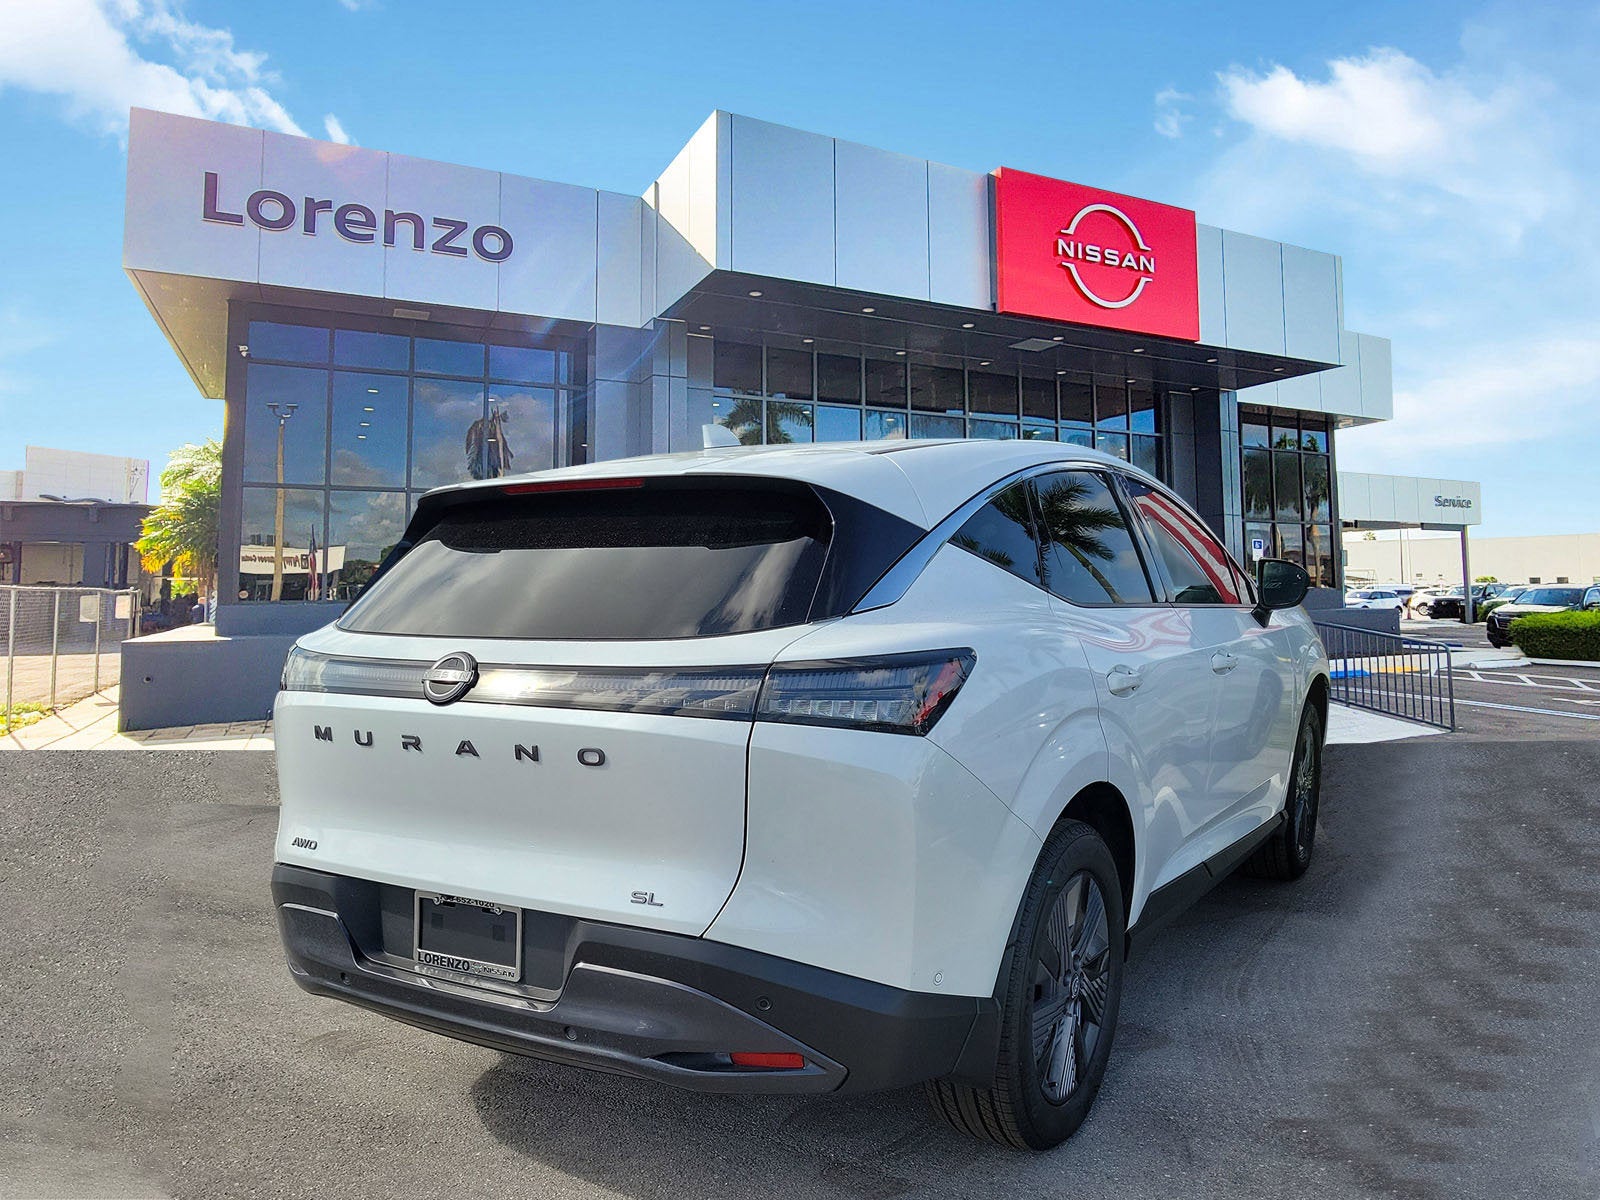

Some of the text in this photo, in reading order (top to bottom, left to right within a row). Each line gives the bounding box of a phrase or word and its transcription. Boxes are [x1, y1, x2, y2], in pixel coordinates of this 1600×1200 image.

[202, 171, 514, 262] Lorenzo
[1057, 238, 1155, 273] NISSAN
[1434, 495, 1472, 509] Service
[314, 725, 606, 766] MURANO
[291, 836, 318, 850] AWD
[630, 890, 664, 906] SL
[418, 952, 515, 978] LORENZO NISSAN
